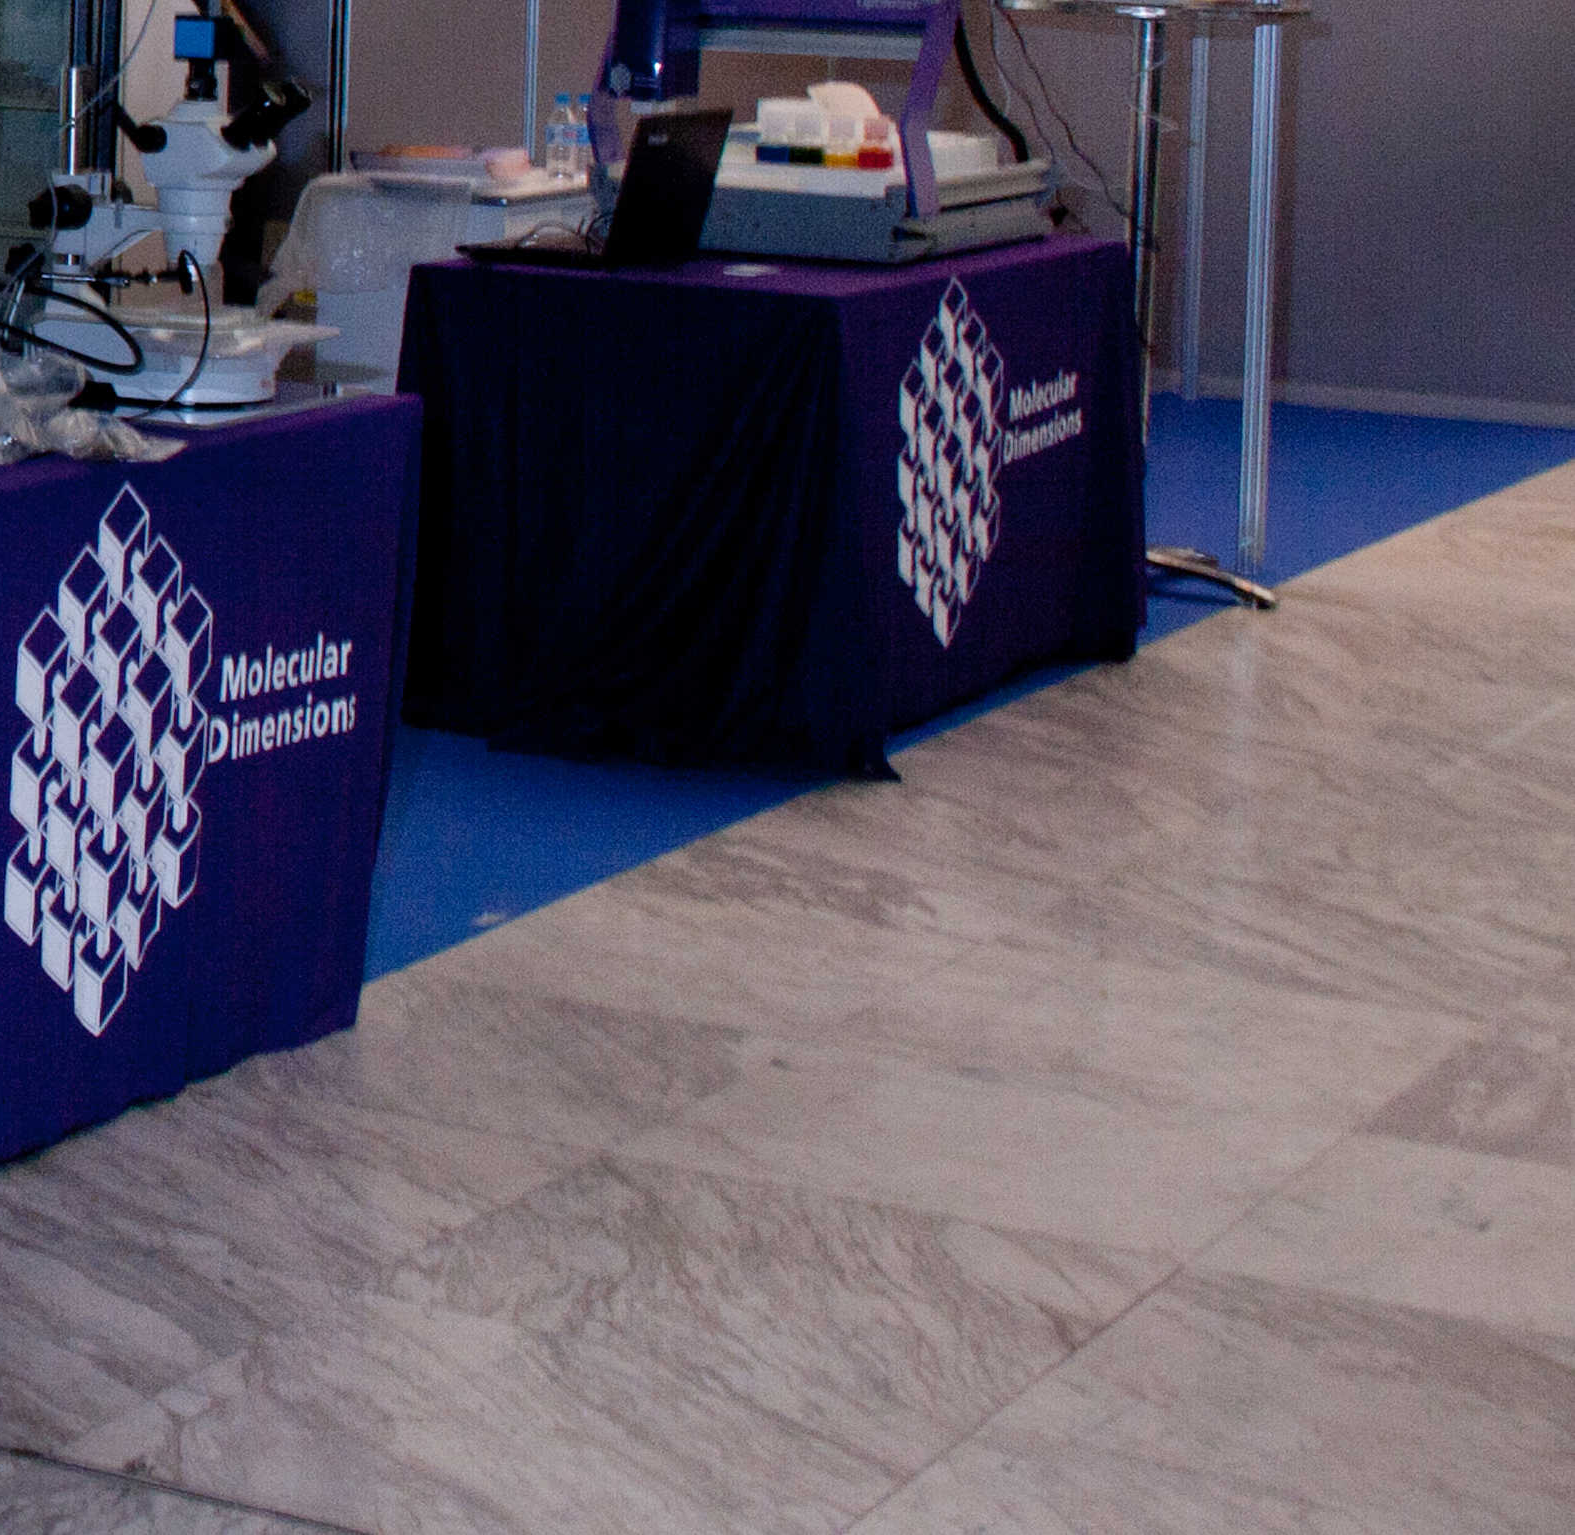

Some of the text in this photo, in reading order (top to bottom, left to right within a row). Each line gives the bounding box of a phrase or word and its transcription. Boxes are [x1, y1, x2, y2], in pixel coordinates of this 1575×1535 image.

[1010, 368, 1078, 422] Molecular
[1003, 408, 1082, 464] Dimensions
[219, 631, 352, 703] Molecular
[207, 692, 357, 763] Dimensions
